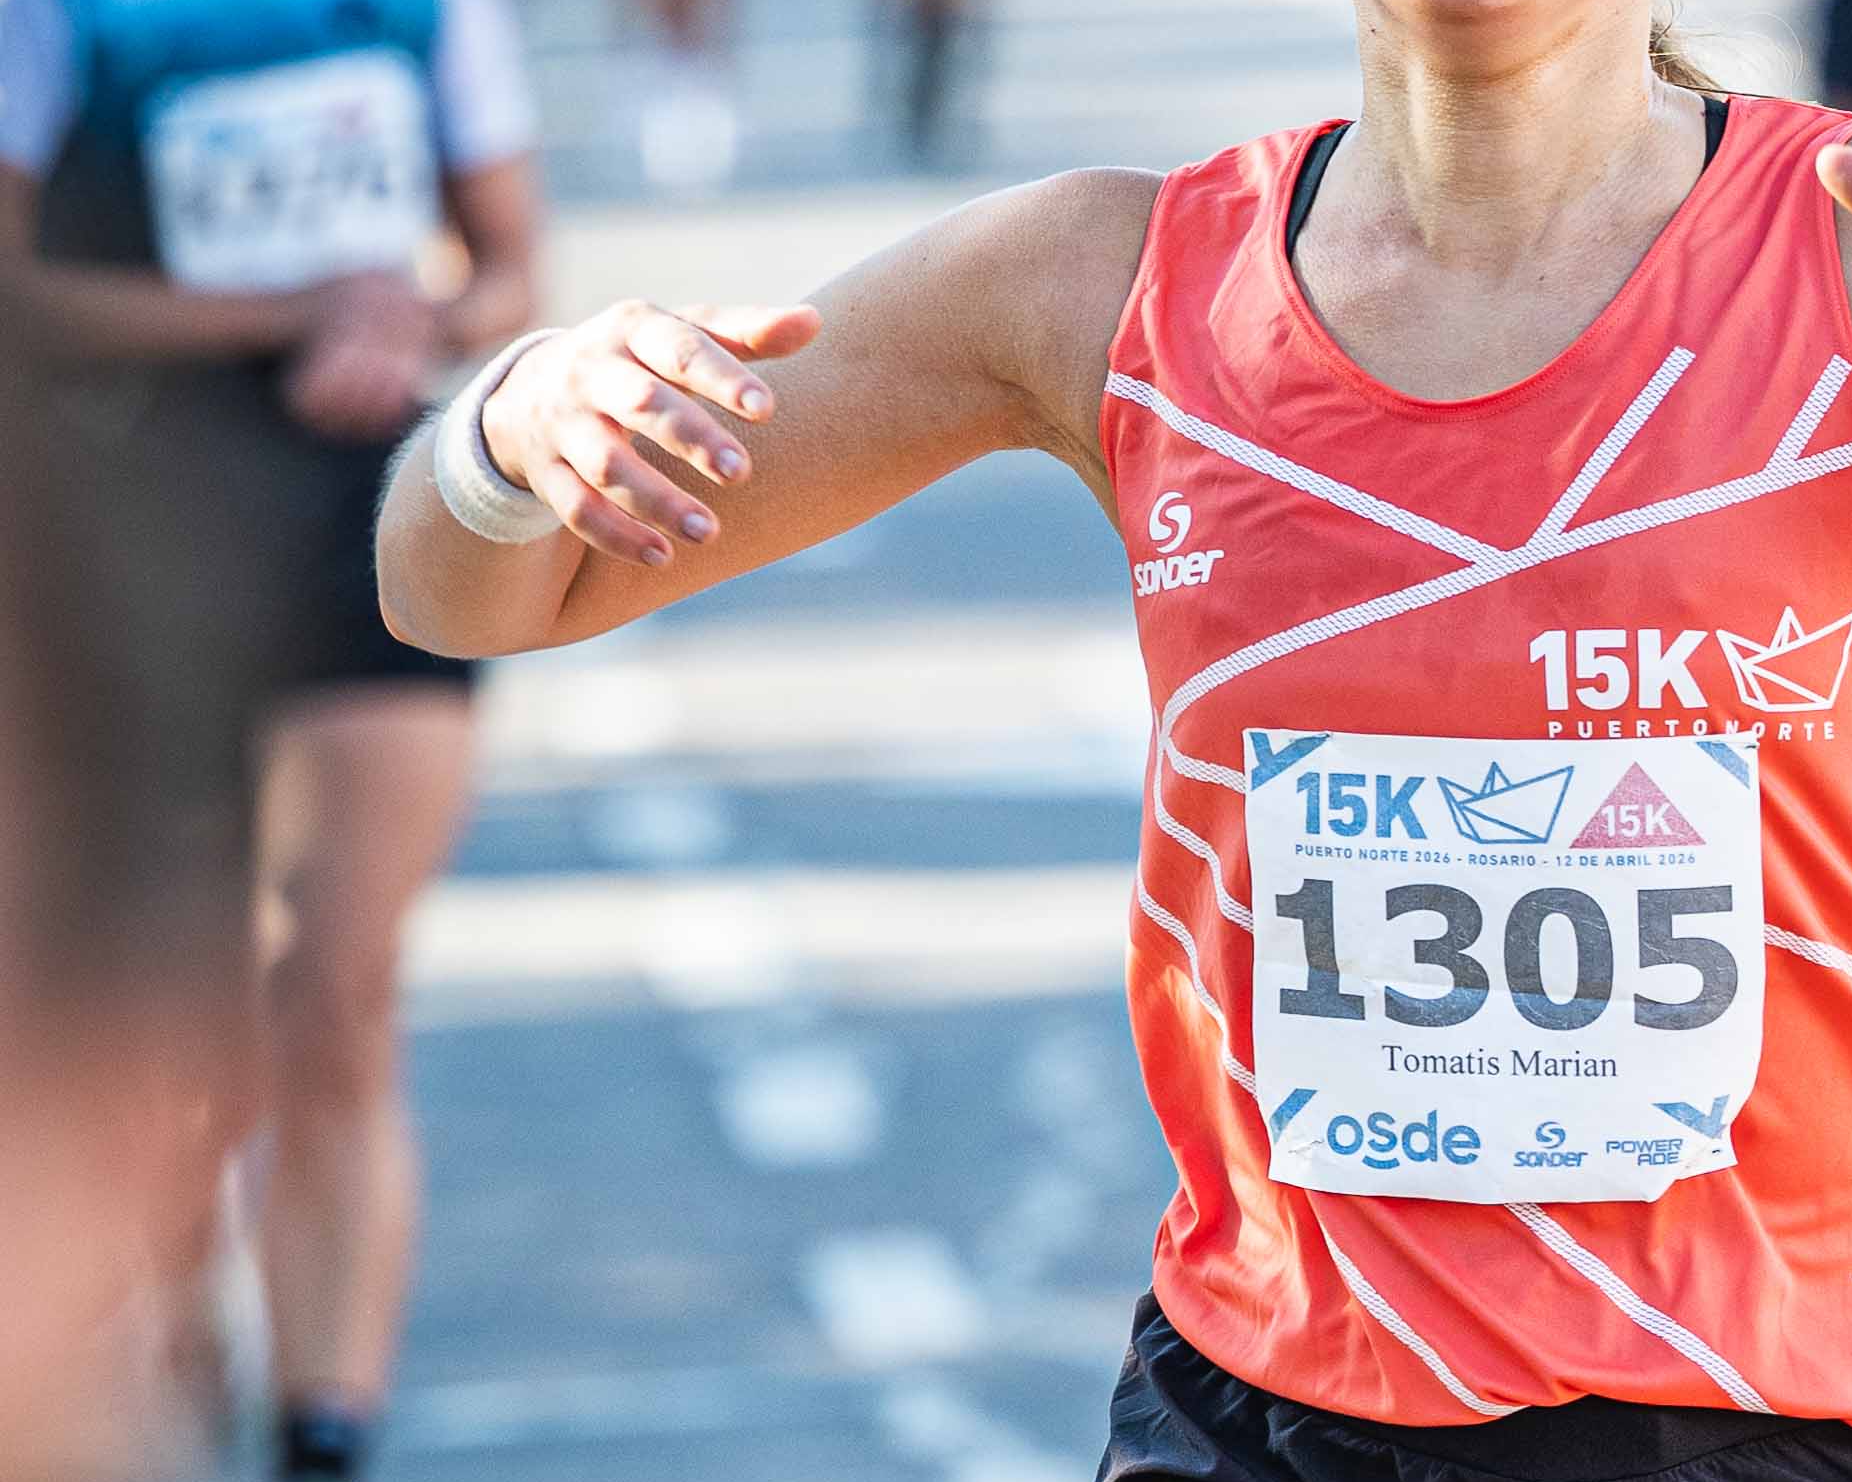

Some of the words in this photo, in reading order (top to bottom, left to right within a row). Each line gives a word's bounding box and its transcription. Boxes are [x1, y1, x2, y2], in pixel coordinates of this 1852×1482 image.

[1529, 628, 1709, 711] 15K
[1547, 718, 1708, 740] PUERTO
[1295, 772, 1428, 840] 15K
[1602, 803, 1673, 839] 15K
[1295, 844, 1352, 859] PUERTO
[1358, 848, 1408, 862] NORTE
[1415, 851, 1451, 864] 2026
[1468, 853, 1536, 866] ROSARIO
[1556, 855, 1573, 867] 12
[1579, 855, 1599, 867] DE
[1604, 854, 1651, 866] ABRIL
[1659, 853, 1696, 865] 2026
[1275, 878, 1738, 1031] 1305
[1381, 1044, 1501, 1077] Tomatis
[1511, 1048, 1618, 1078] Marian
[1327, 1110, 1481, 1164] osde
[1606, 1138, 1683, 1154] POWER
[1637, 1152, 1680, 1166] ADE
